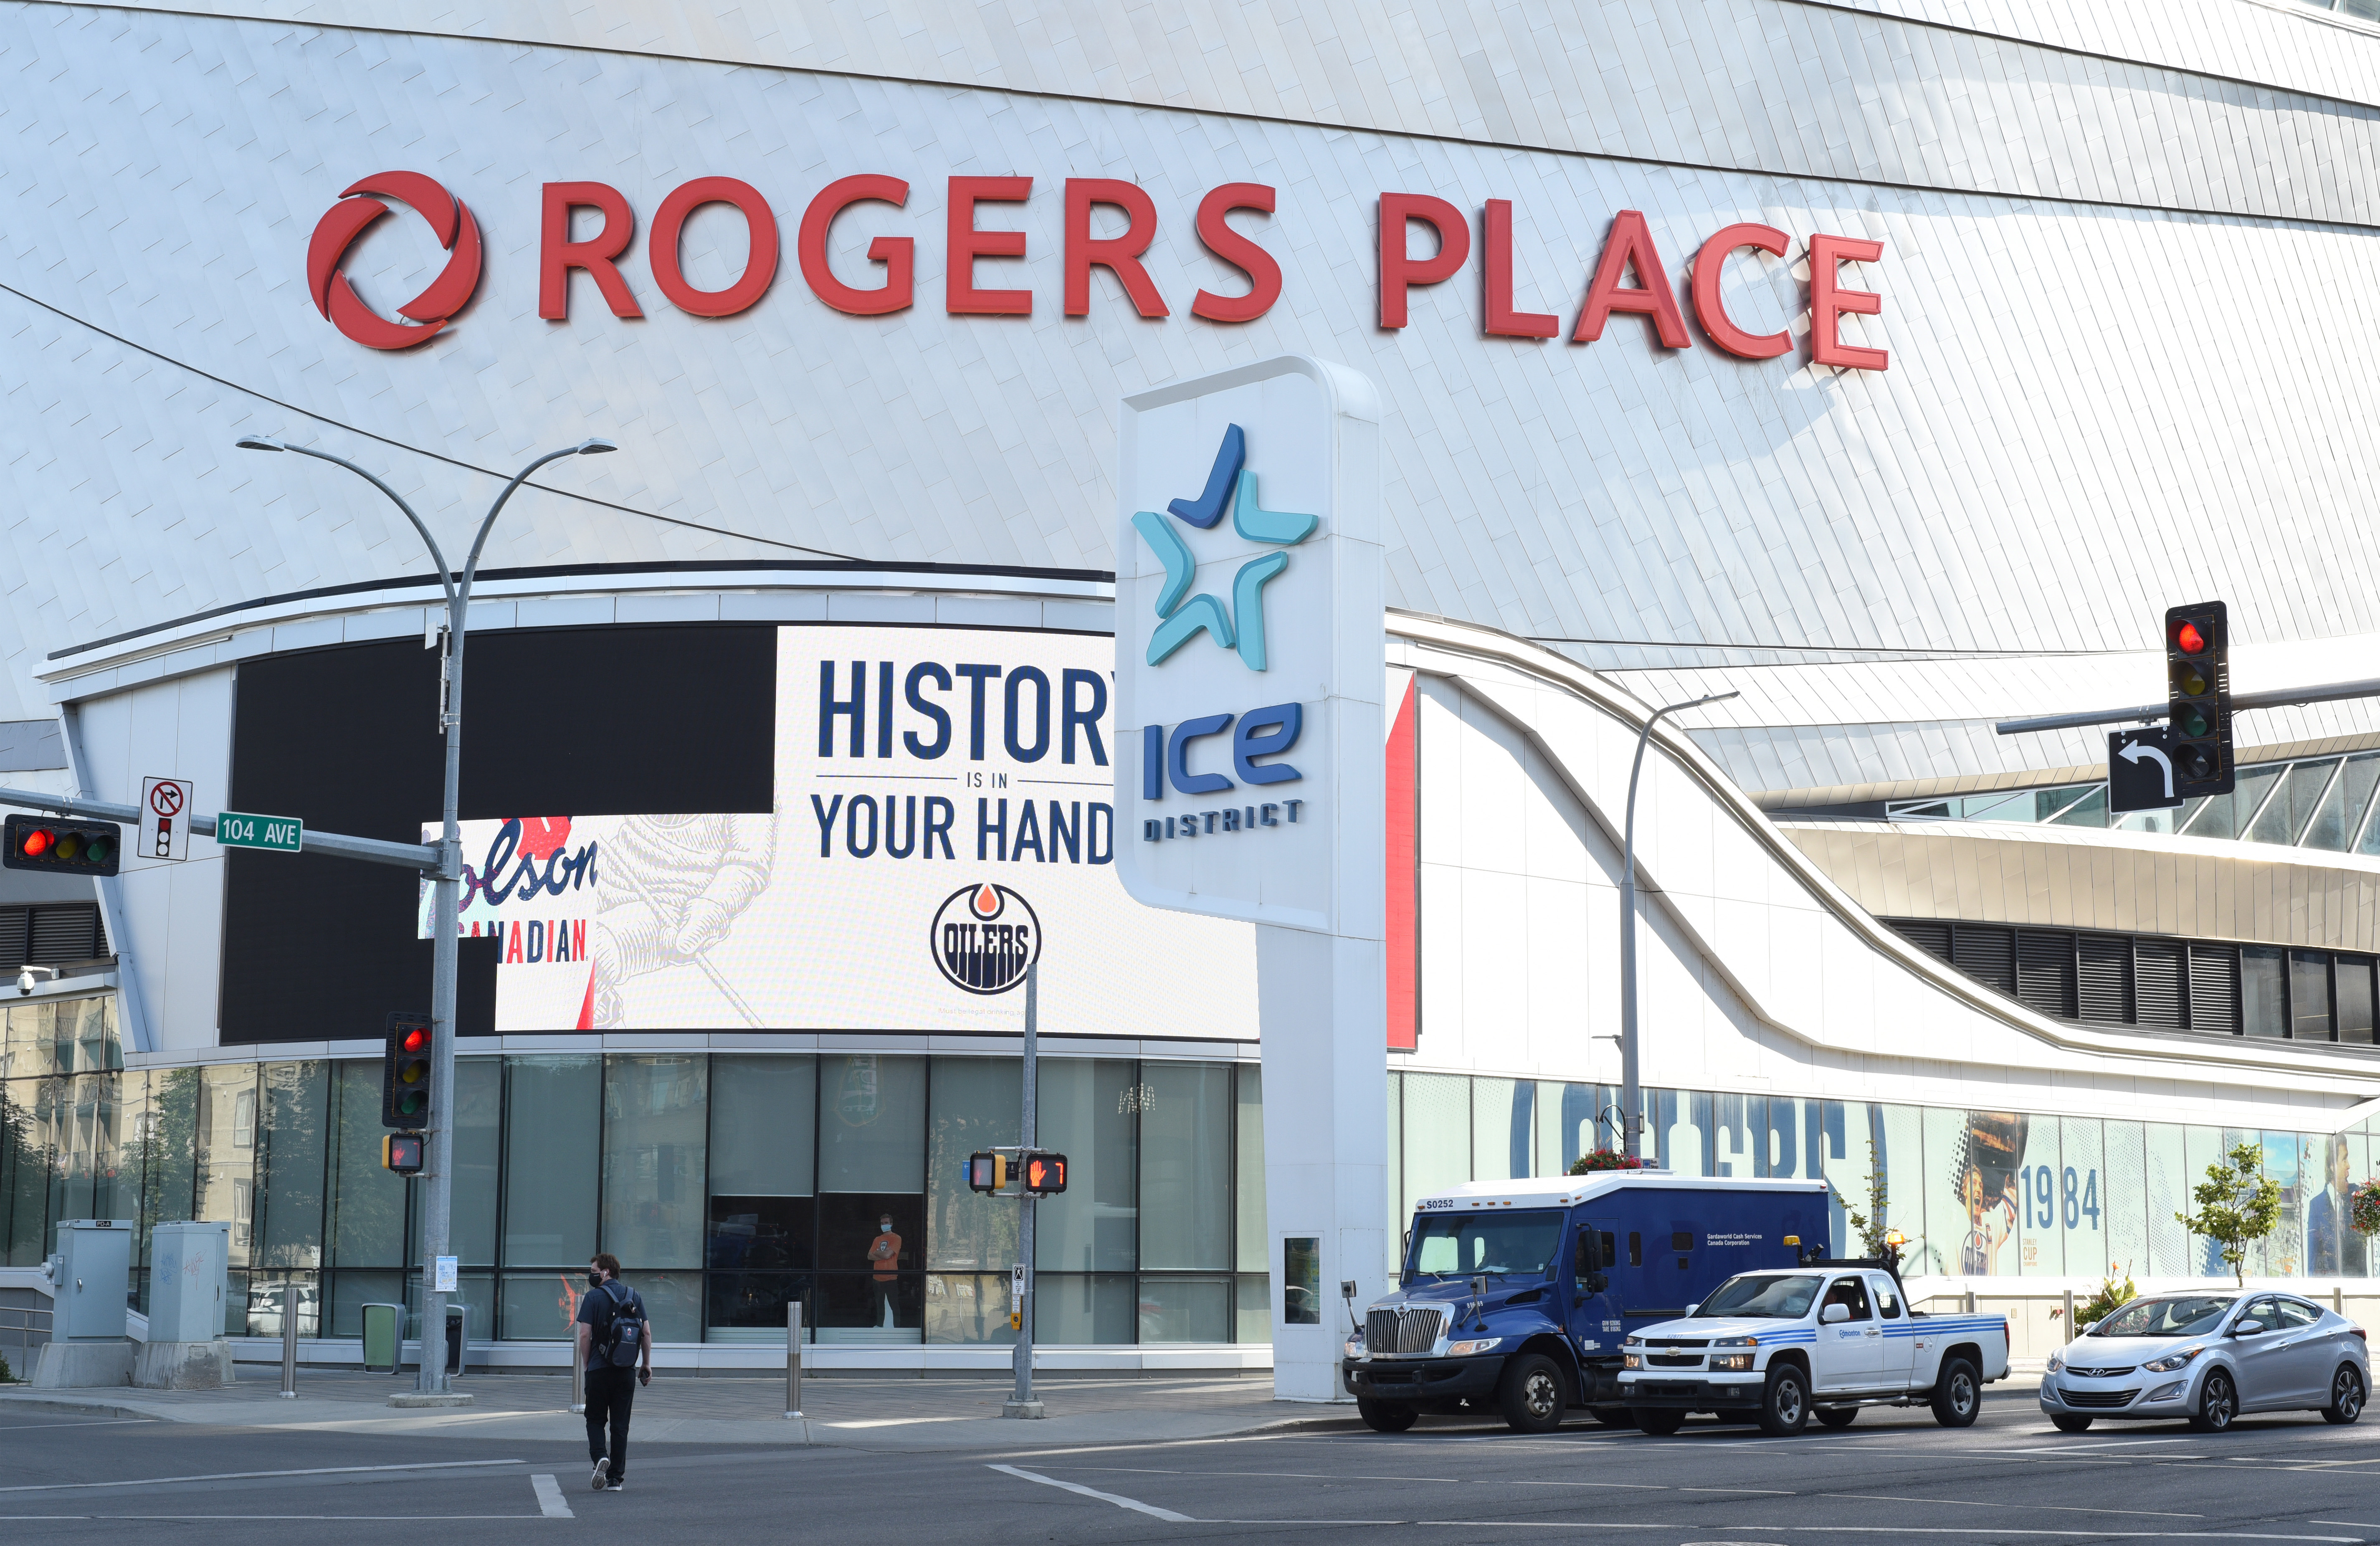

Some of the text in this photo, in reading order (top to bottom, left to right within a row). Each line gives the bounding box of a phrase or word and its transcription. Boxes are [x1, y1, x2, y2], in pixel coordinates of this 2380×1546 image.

[539, 174, 1888, 370] ROGERS PLACE
[819, 660, 1114, 767] HISTOR
[967, 772, 1007, 788] IS IN
[223, 819, 296, 845] 104 AVE
[810, 795, 955, 859] YOUR
[1144, 799, 1302, 842] DISTRICT
[419, 818, 598, 925] olson
[458, 919, 586, 964] NADIAN
[1427, 1199, 1453, 1209] S0252
[2021, 1164, 2100, 1230] 1984
[2023, 1247, 2037, 1260] CUP
[1839, 1329, 1861, 1339] Edmonton
